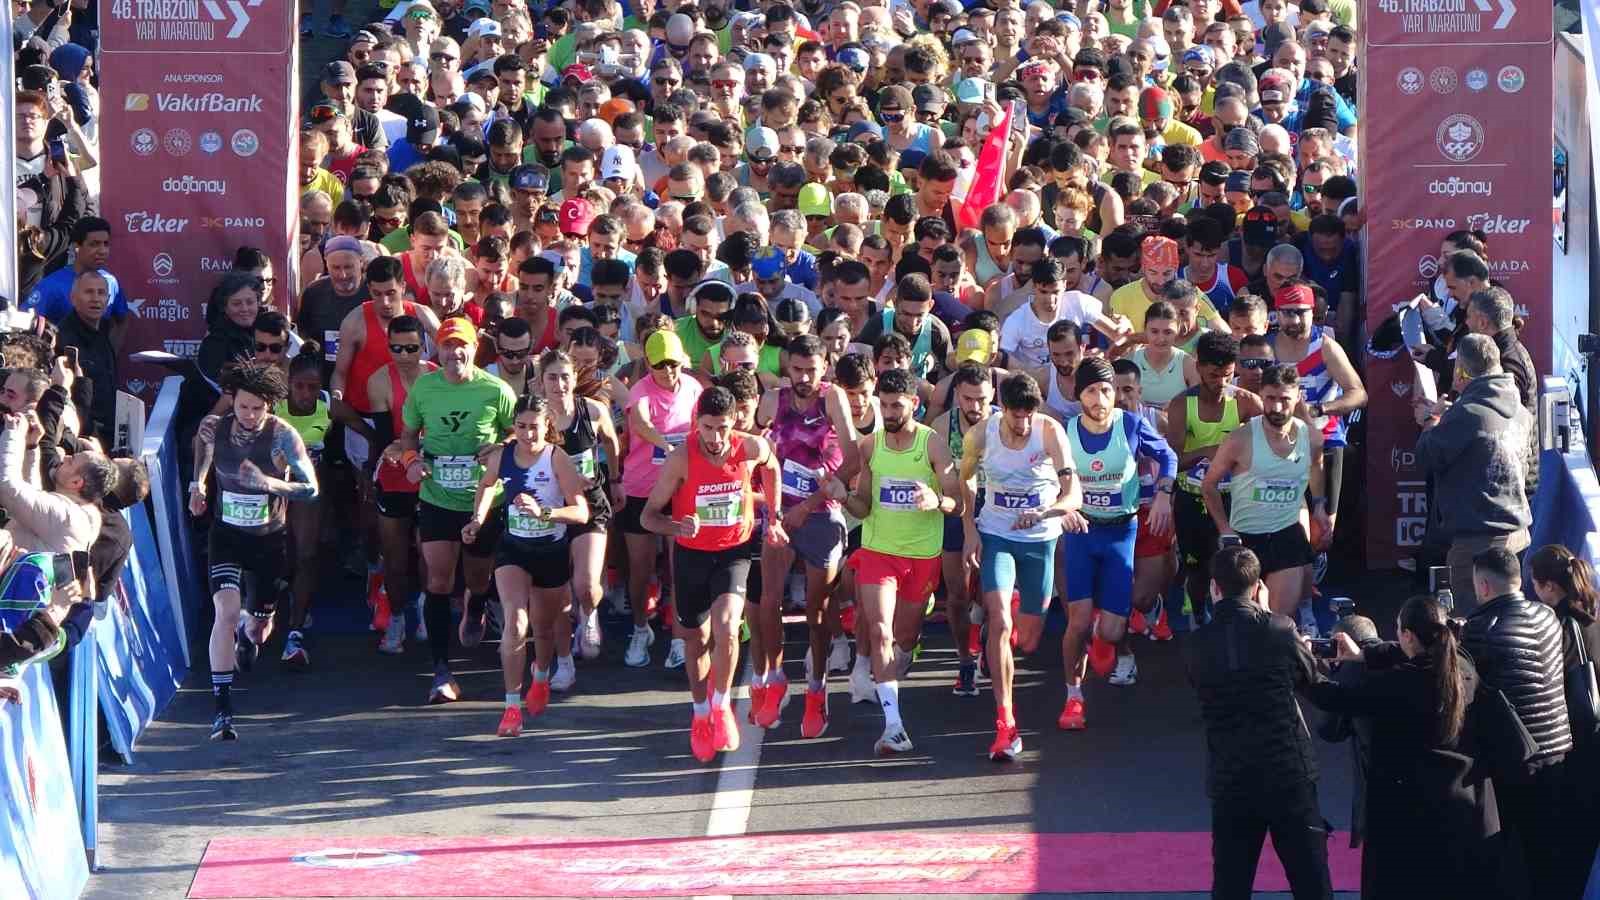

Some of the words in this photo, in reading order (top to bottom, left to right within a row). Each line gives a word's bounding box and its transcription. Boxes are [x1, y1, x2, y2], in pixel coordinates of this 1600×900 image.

[1403, 14, 1424, 32] YARI
[1428, 13, 1481, 32] MARATONU
[136, 23, 157, 40] YARI
[161, 22, 215, 41] MARATONU
[164, 74, 182, 83] ANA
[183, 74, 224, 84] SPONSOR
[157, 93, 263, 112] VakıfBank
[163, 176, 226, 195] doğanay
[1429, 176, 1492, 196] doğanay
[201, 257, 233, 271] RAM
[1487, 260, 1529, 271] MADA
[437, 467, 472, 482] 1369
[796, 476, 811, 491] 15
[1004, 495, 1030, 508] 172
[1085, 494, 1111, 506] 129
[1259, 488, 1297, 502] 1040
